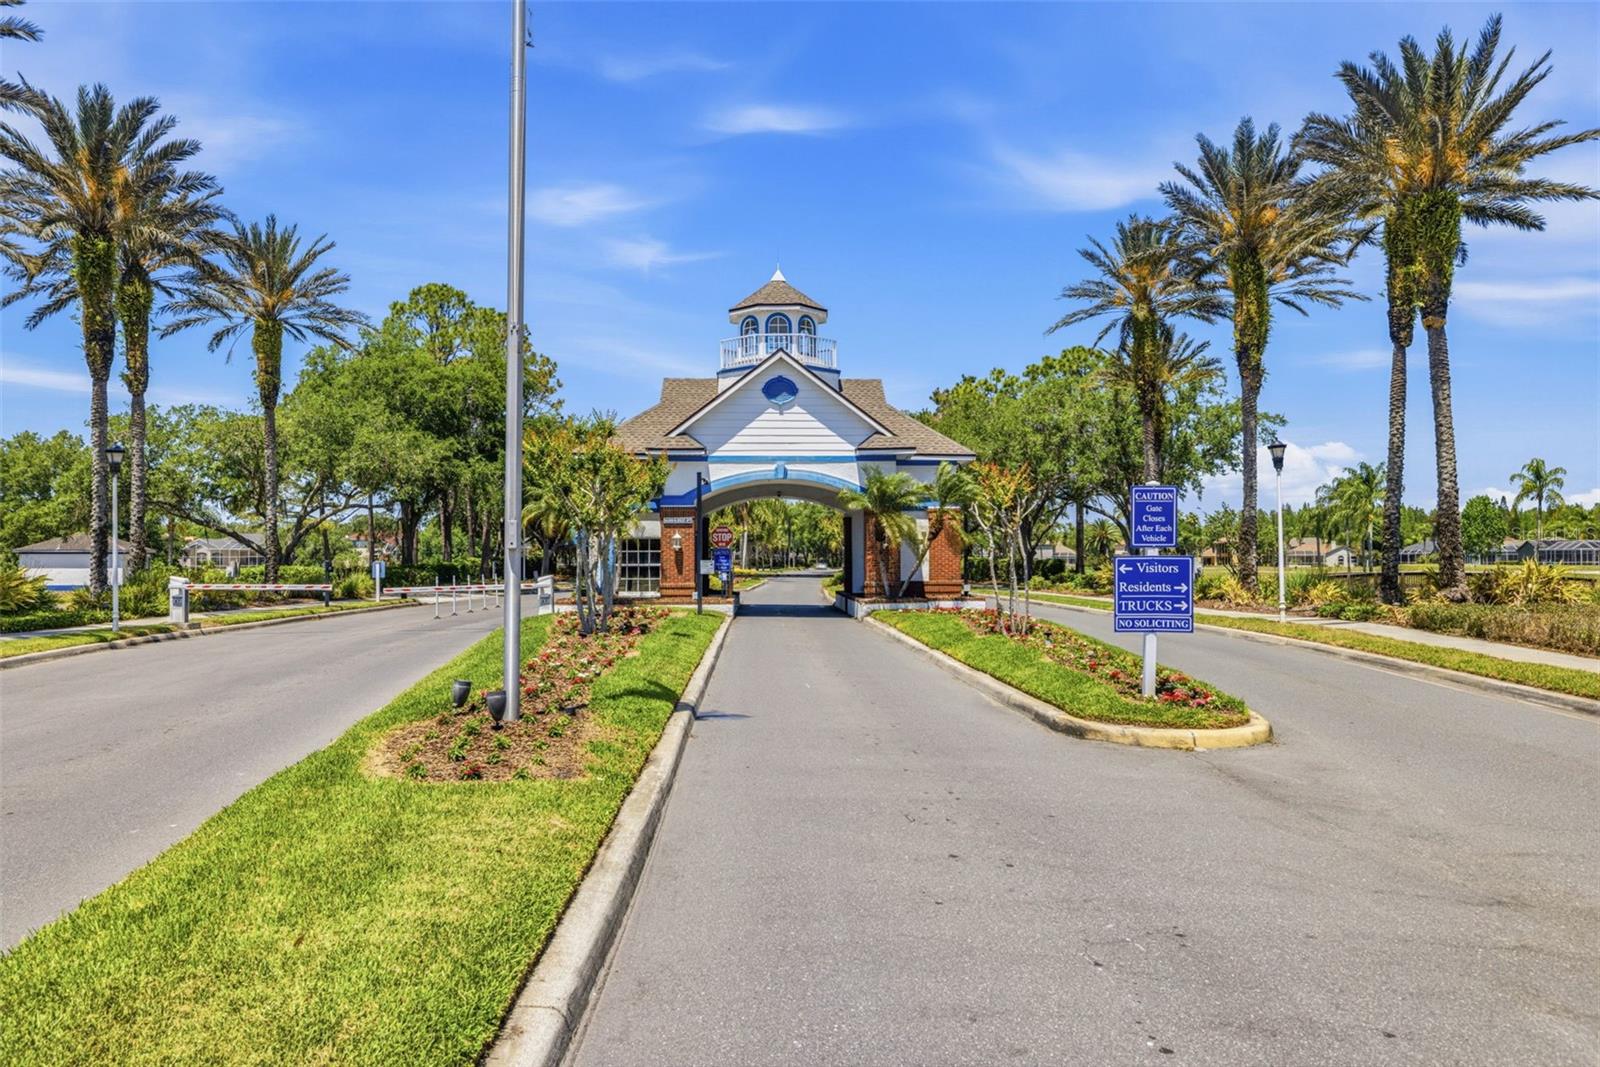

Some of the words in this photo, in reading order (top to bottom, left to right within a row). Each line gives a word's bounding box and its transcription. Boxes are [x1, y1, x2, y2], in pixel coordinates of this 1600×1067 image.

[1135, 492, 1174, 500] CAUTION
[1146, 504, 1163, 512] Gate
[1142, 514, 1165, 522] Closes
[1136, 525, 1154, 533] After
[1155, 525, 1172, 533] Each
[712, 532, 732, 541] STOP
[1137, 563, 1179, 573] Visitors
[1119, 581, 1171, 592] Residents
[1119, 600, 1172, 611] TRUCKS
[1119, 619, 1132, 628] NO
[1134, 619, 1189, 628] SOLICITING
